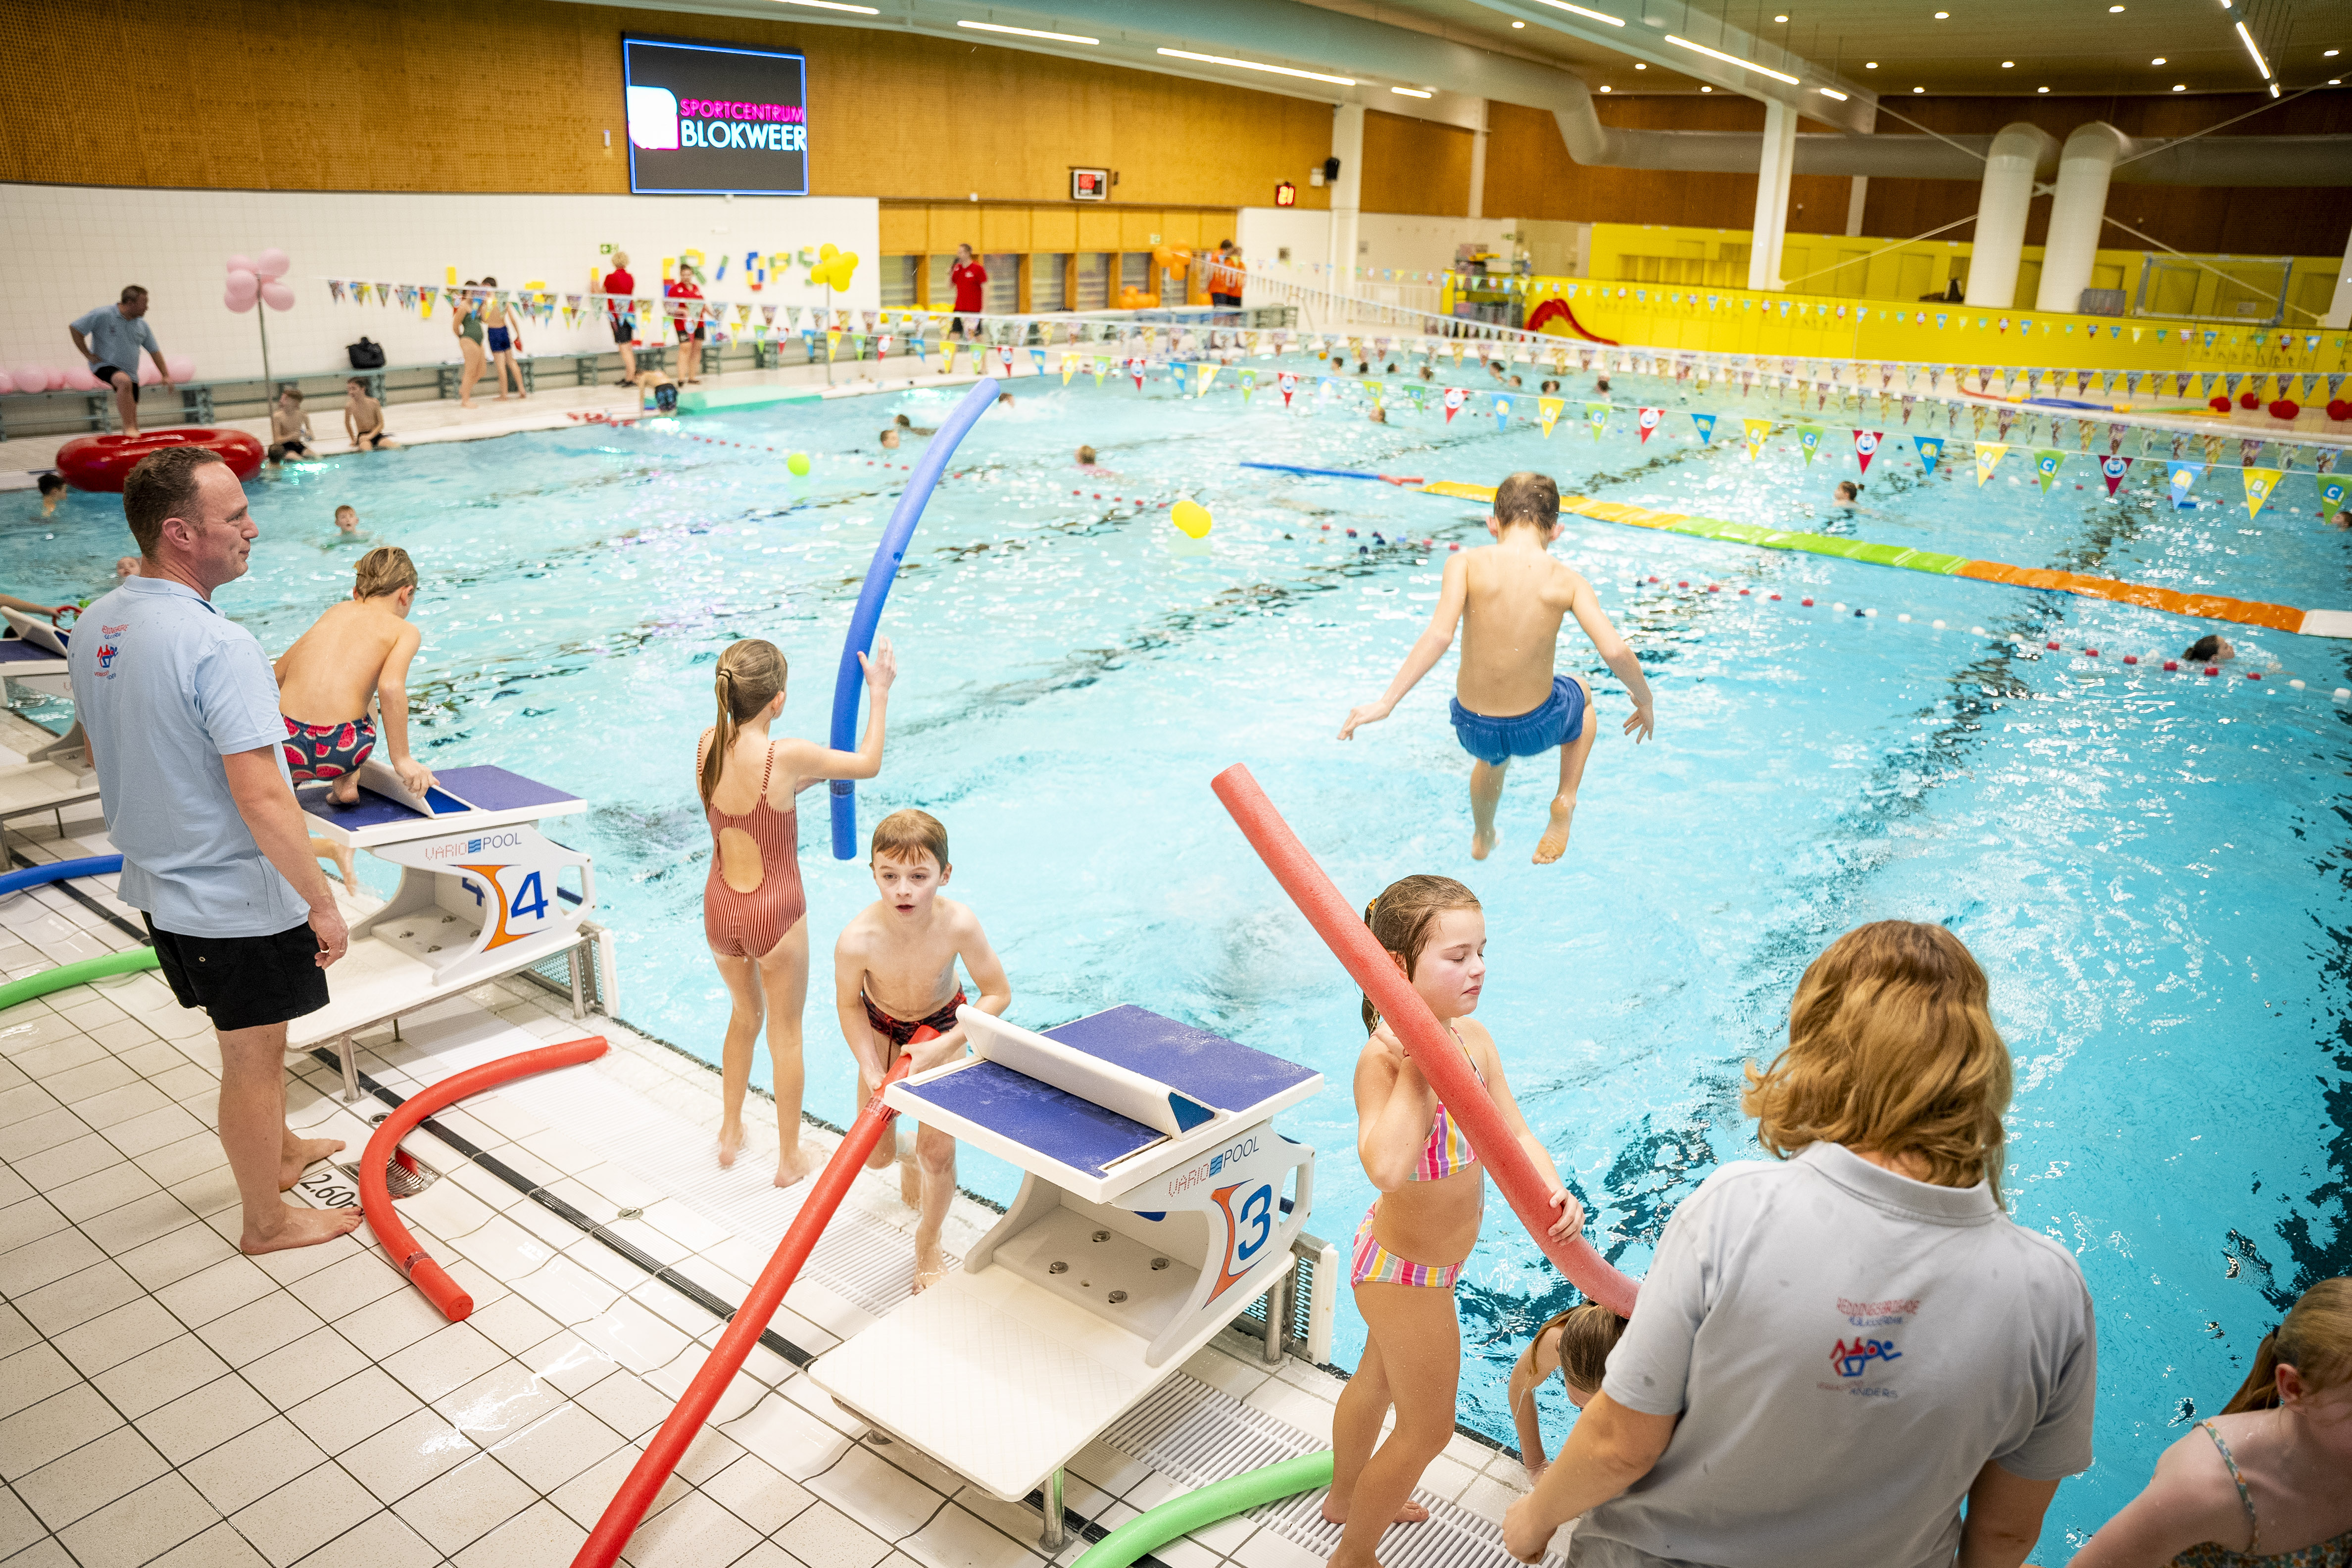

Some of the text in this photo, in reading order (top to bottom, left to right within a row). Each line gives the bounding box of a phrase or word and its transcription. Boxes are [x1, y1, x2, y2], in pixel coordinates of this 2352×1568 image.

[680, 98, 805, 122] SPORTCENTRUM
[681, 119, 807, 151] BLOKWEER
[2043, 459, 2053, 470] C
[2252, 480, 2263, 491] B
[2327, 487, 2339, 497] C
[425, 833, 522, 861] VARIO POOL
[510, 870, 548, 920] 4
[1169, 1136, 1259, 1197] VARIO POOL
[1238, 1184, 1272, 1261] 3
